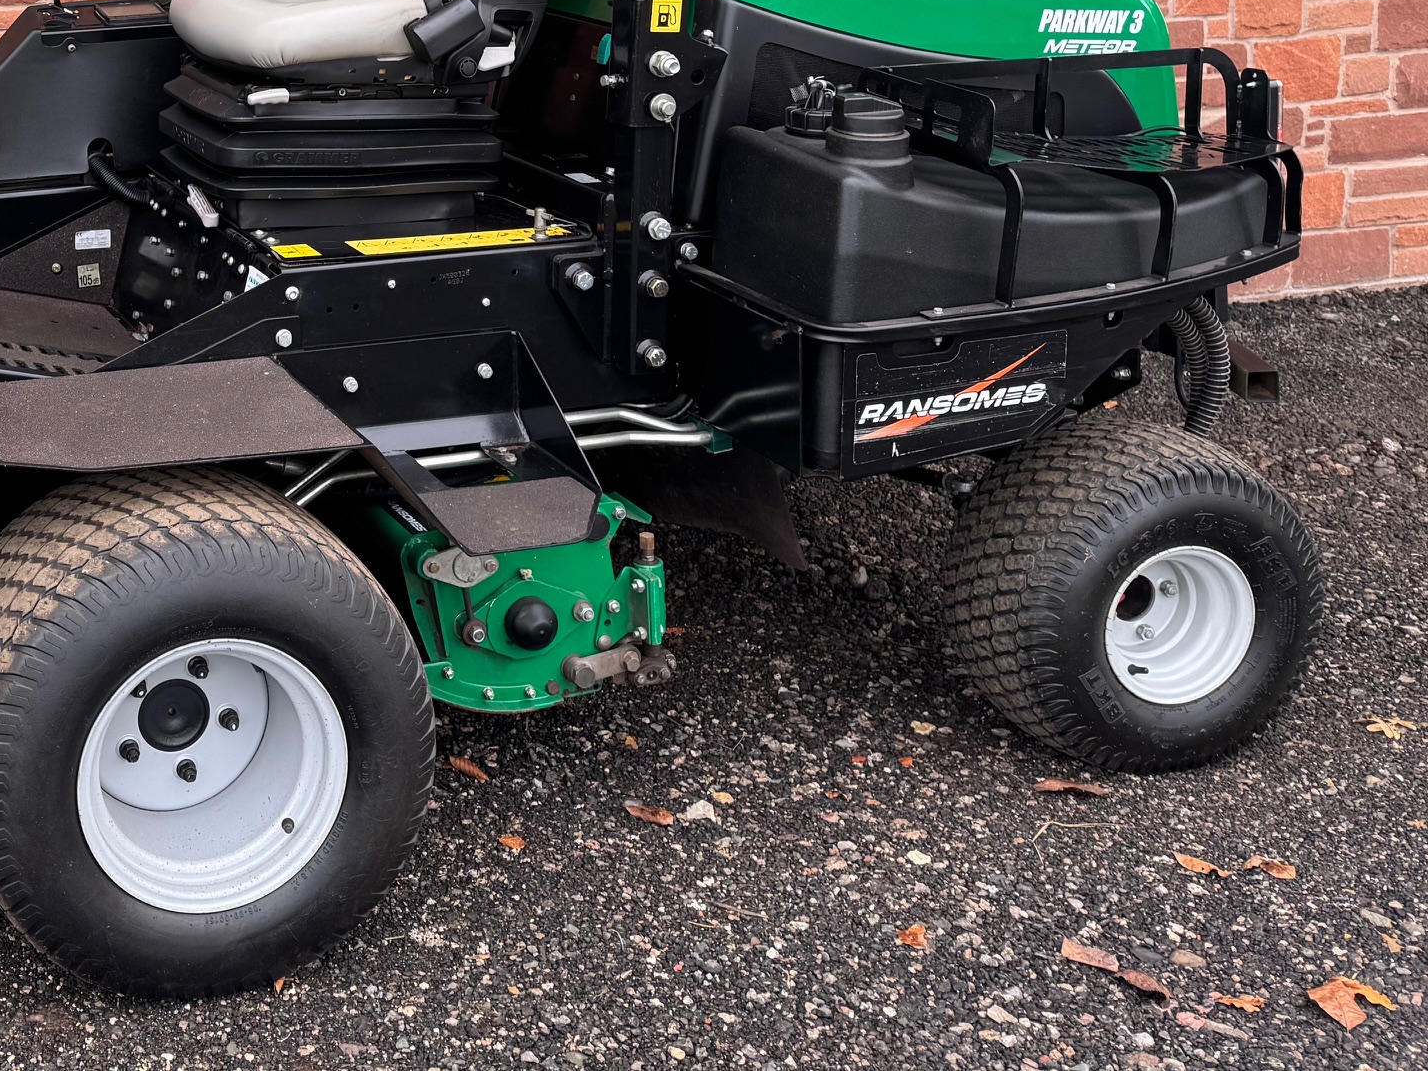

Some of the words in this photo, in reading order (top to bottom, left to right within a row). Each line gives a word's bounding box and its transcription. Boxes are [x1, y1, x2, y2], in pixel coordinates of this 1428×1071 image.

[1037, 8, 1131, 34] PARKWAY
[1128, 9, 1145, 34] 3
[1042, 38, 1138, 55] METEOR
[272, 151, 361, 166] GRAMMER
[79, 274, 93, 287] 105
[857, 382, 1048, 426] RANSOMES
